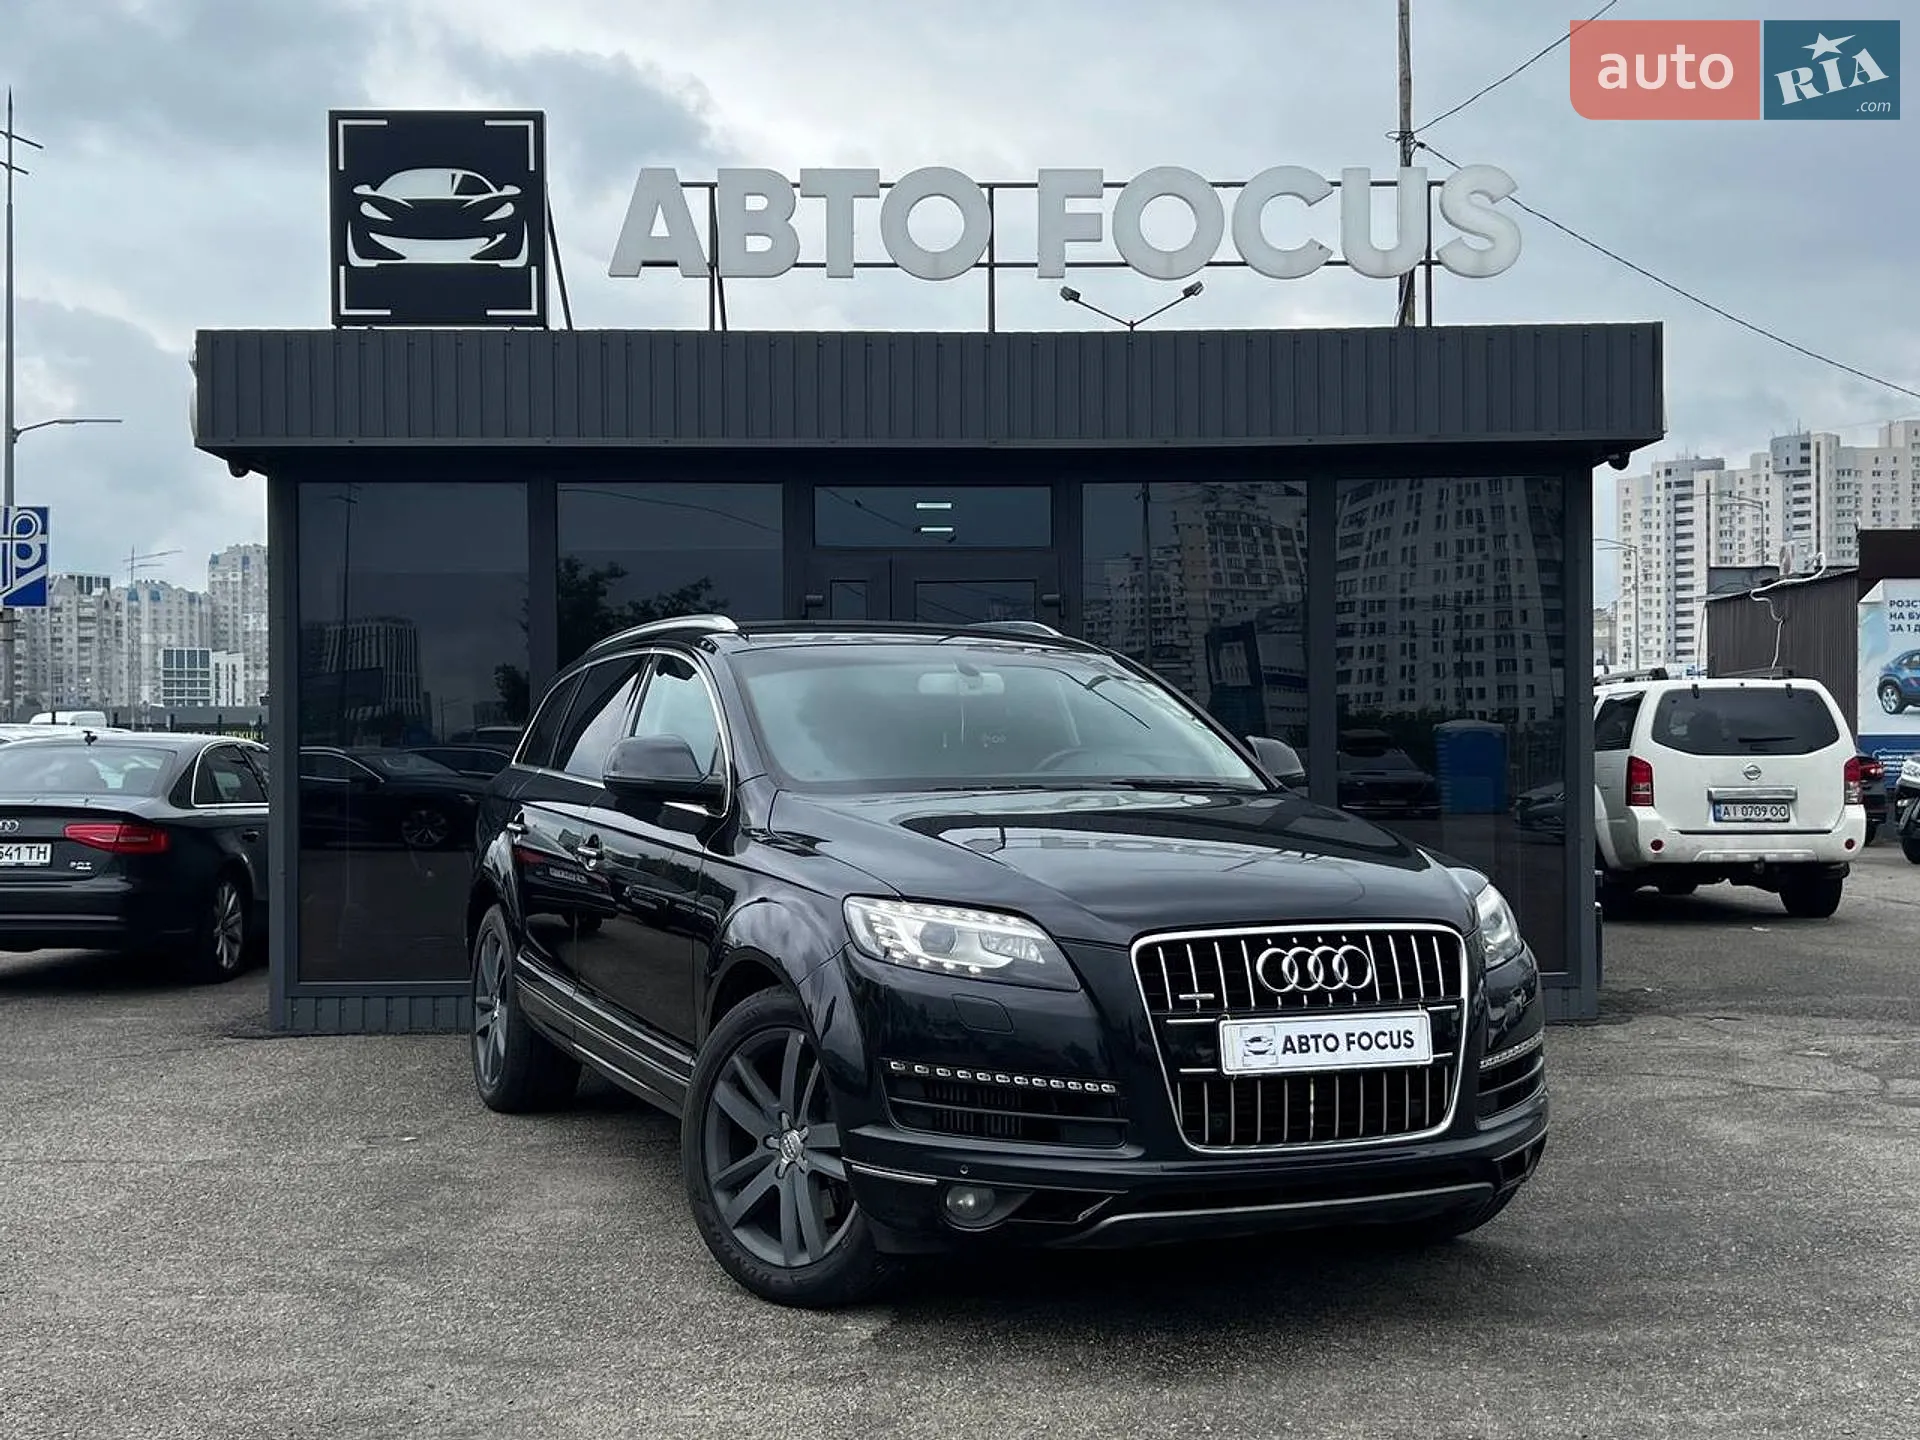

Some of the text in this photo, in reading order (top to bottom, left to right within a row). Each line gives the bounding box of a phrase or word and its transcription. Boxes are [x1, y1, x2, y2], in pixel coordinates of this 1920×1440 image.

[608, 164, 1522, 281] АВТО FOCUS
[1889, 599, 1920, 608] РОЗС
[1889, 611, 1904, 620] НА
[1724, 806, 1737, 816] AI
[1741, 805, 1768, 816] 0709
[25, 845, 47, 860] TH
[1282, 1030, 1415, 1055] АВТО FOCUS
